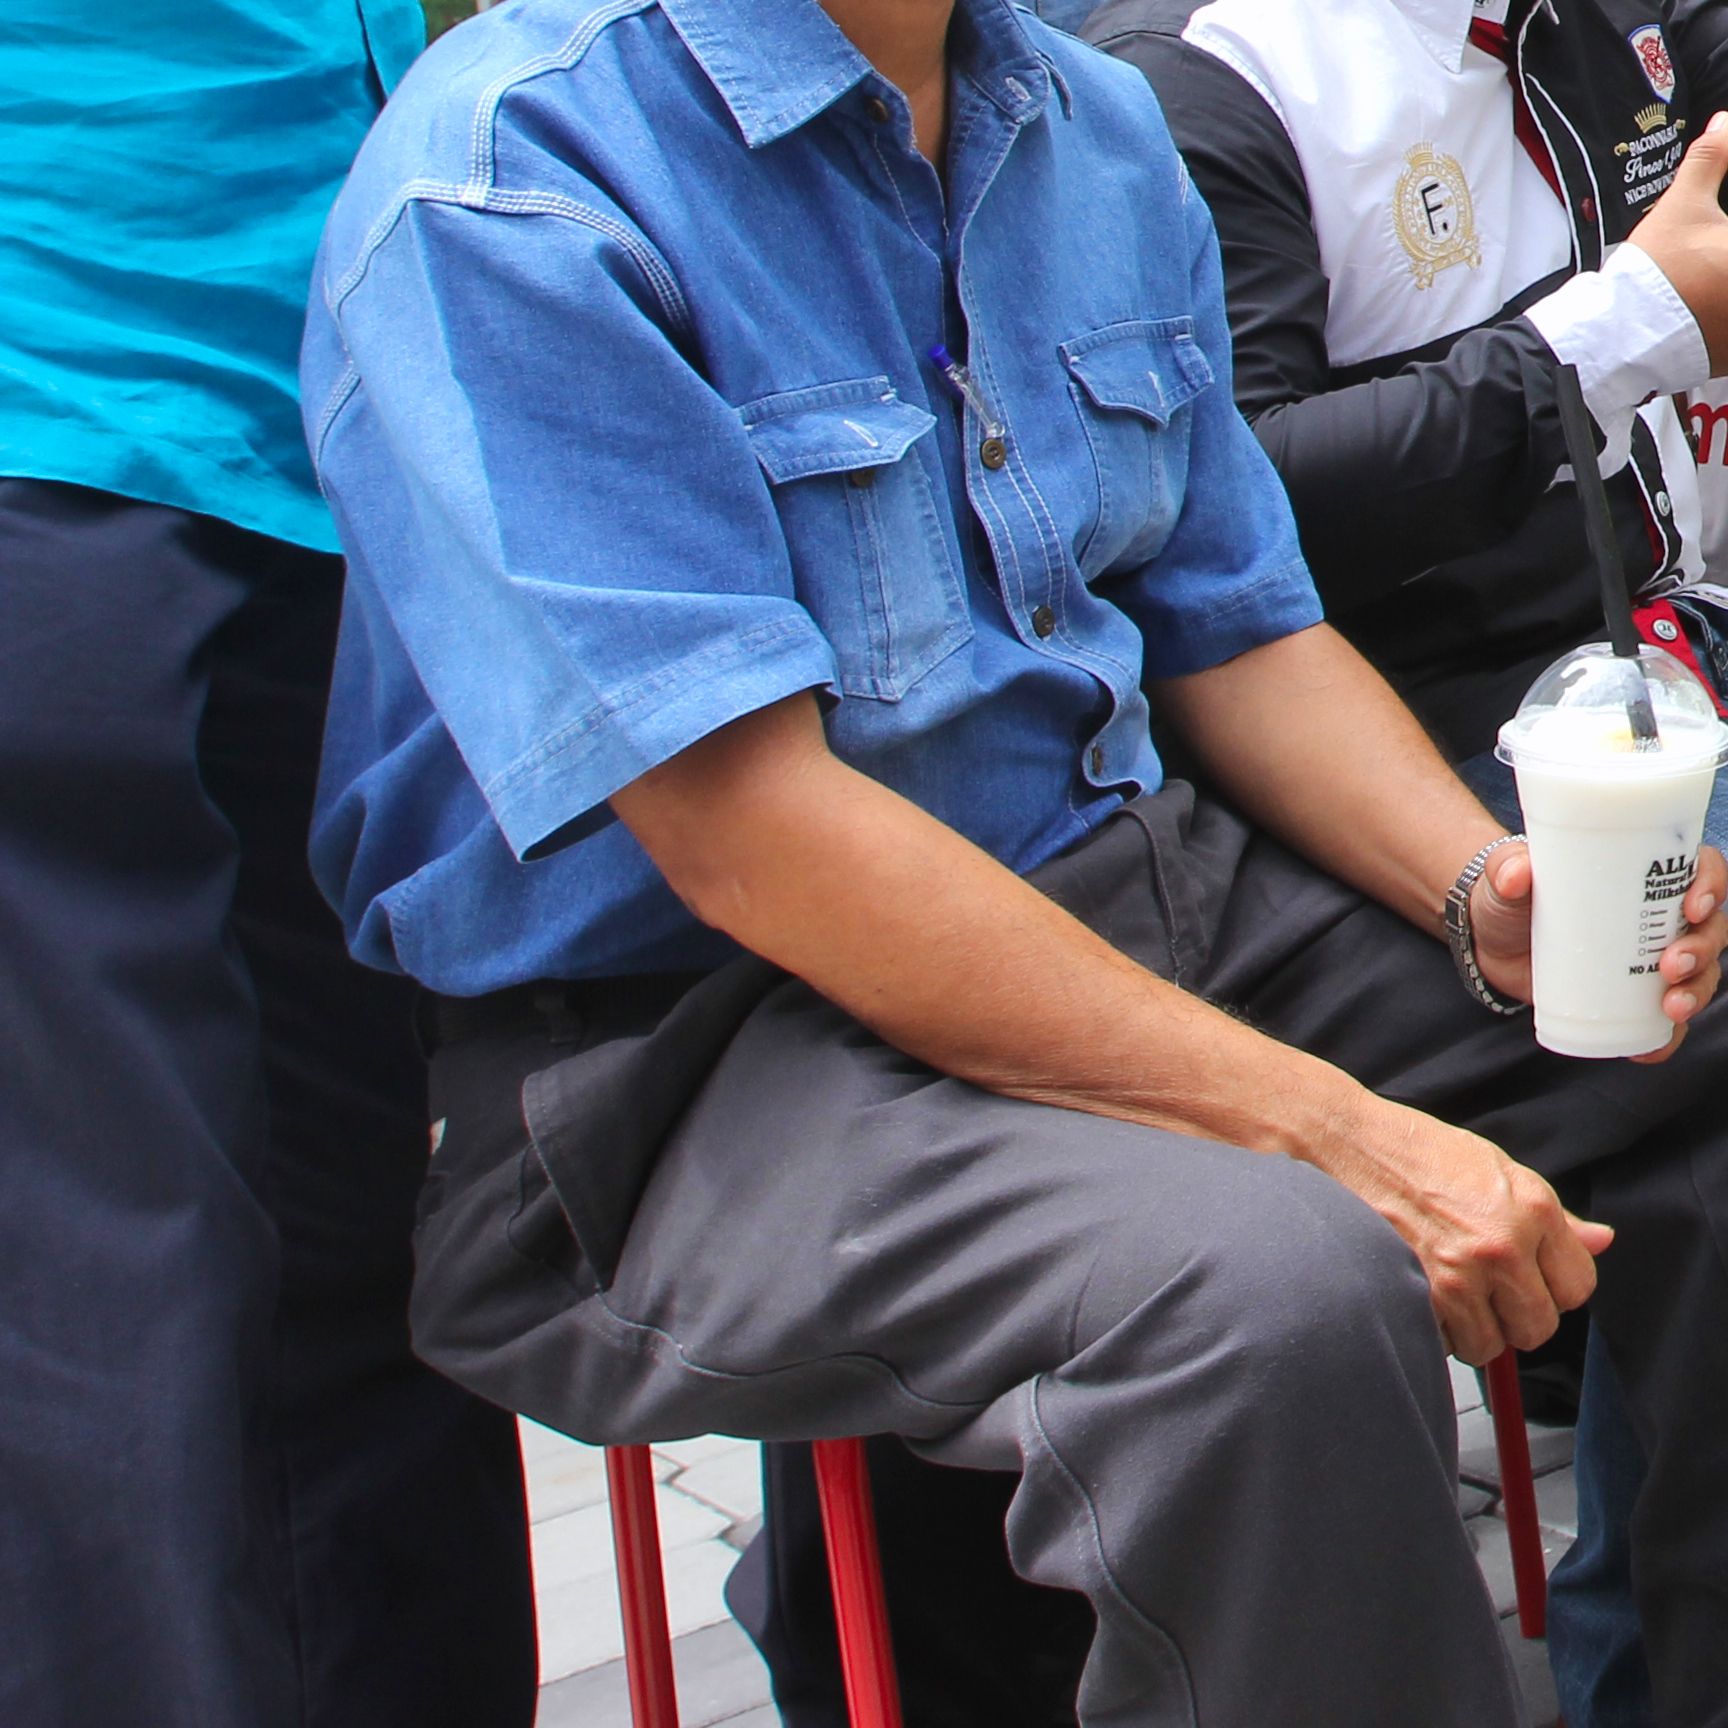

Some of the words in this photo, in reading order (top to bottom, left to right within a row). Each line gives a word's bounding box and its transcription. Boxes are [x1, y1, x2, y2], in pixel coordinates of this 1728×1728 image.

[1645, 854, 1687, 878] ALL
[1645, 873, 1688, 889] Natural
[1629, 964, 1645, 976] NO
